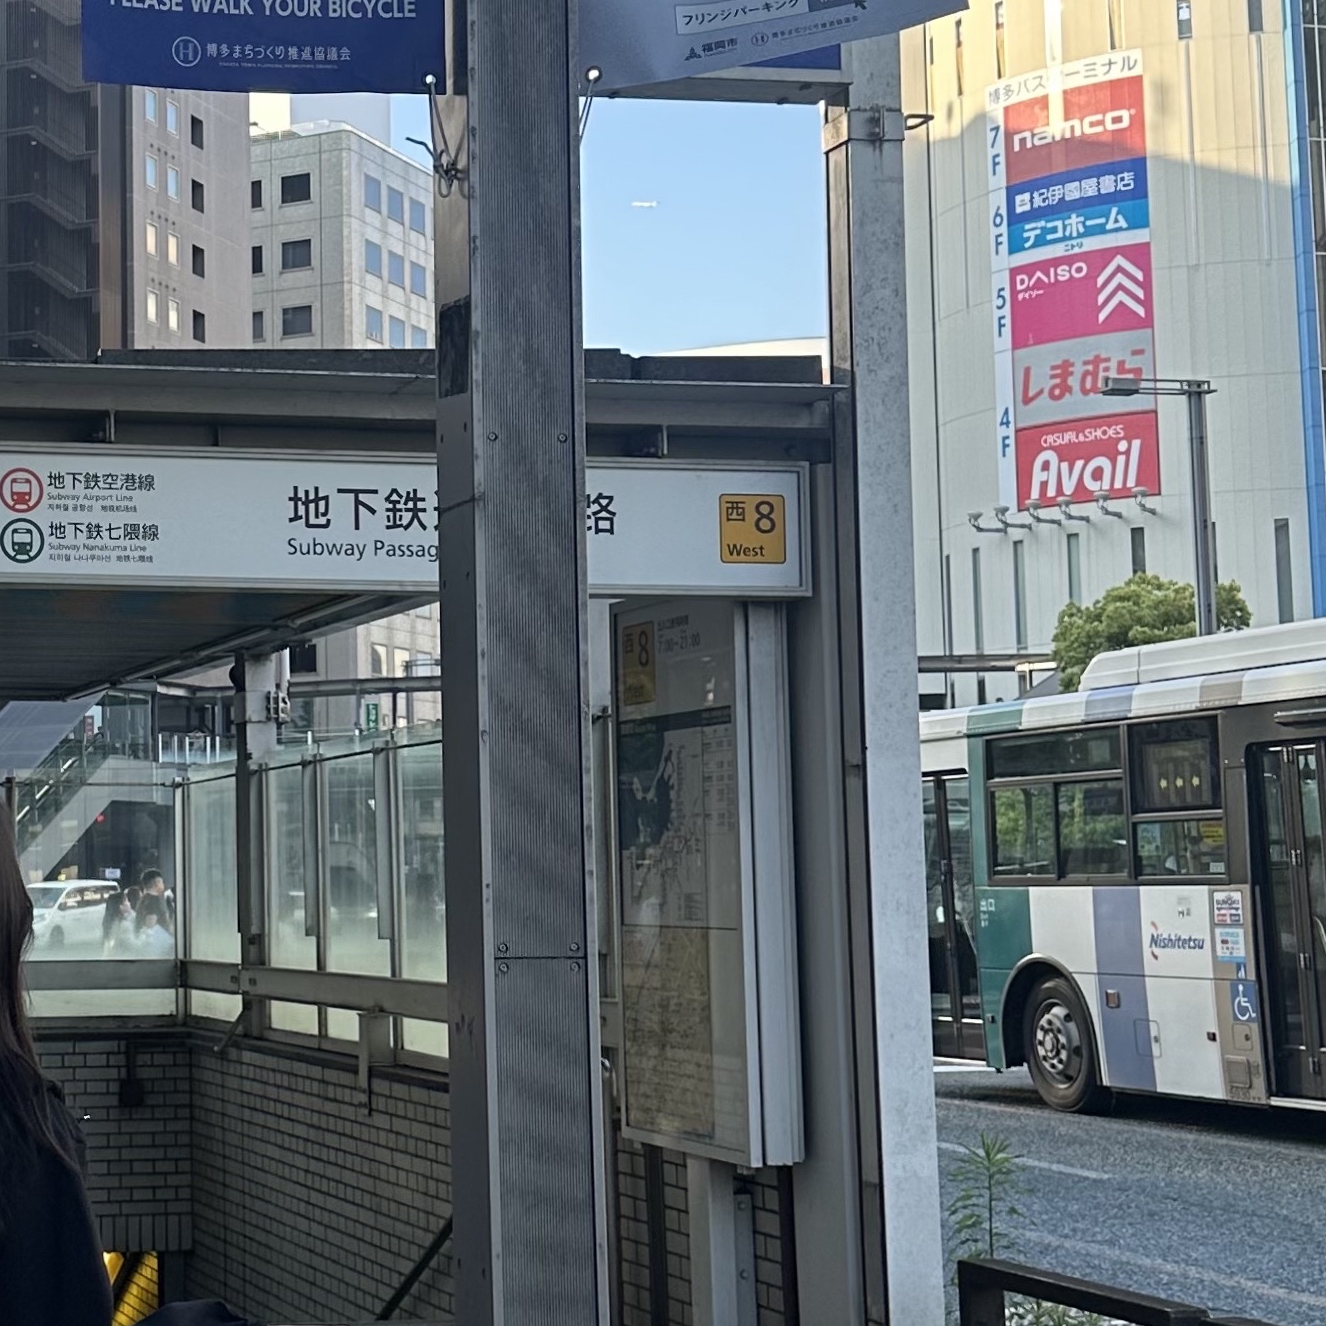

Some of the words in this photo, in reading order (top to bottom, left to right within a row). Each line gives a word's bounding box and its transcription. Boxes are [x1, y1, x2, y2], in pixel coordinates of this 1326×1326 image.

[262, 0, 322, 17] YOUR
[328, 0, 417, 18] BICYCLE
[988, 55, 1138, 105] 博多バスーミナル
[1013, 109, 1131, 152] namco
[1023, 207, 1129, 249] デコホーム
[1016, 262, 1088, 290] DAISO
[1030, 439, 1142, 500] Avail
[47, 471, 156, 492] 地下鉄空港線
[47, 493, 80, 502] Subway
[83, 493, 113, 502] Airport
[724, 500, 746, 522] 西
[754, 500, 776, 534] 8
[48, 521, 160, 542] 地下鉄七隈線
[48, 543, 81, 552] Subway
[83, 543, 127, 552] Nanakuma
[130, 544, 148, 552] Line
[287, 538, 367, 561] Subway
[373, 539, 438, 562] Passag
[727, 543, 765, 557] West
[1149, 932, 1205, 950] Nishitetsu
